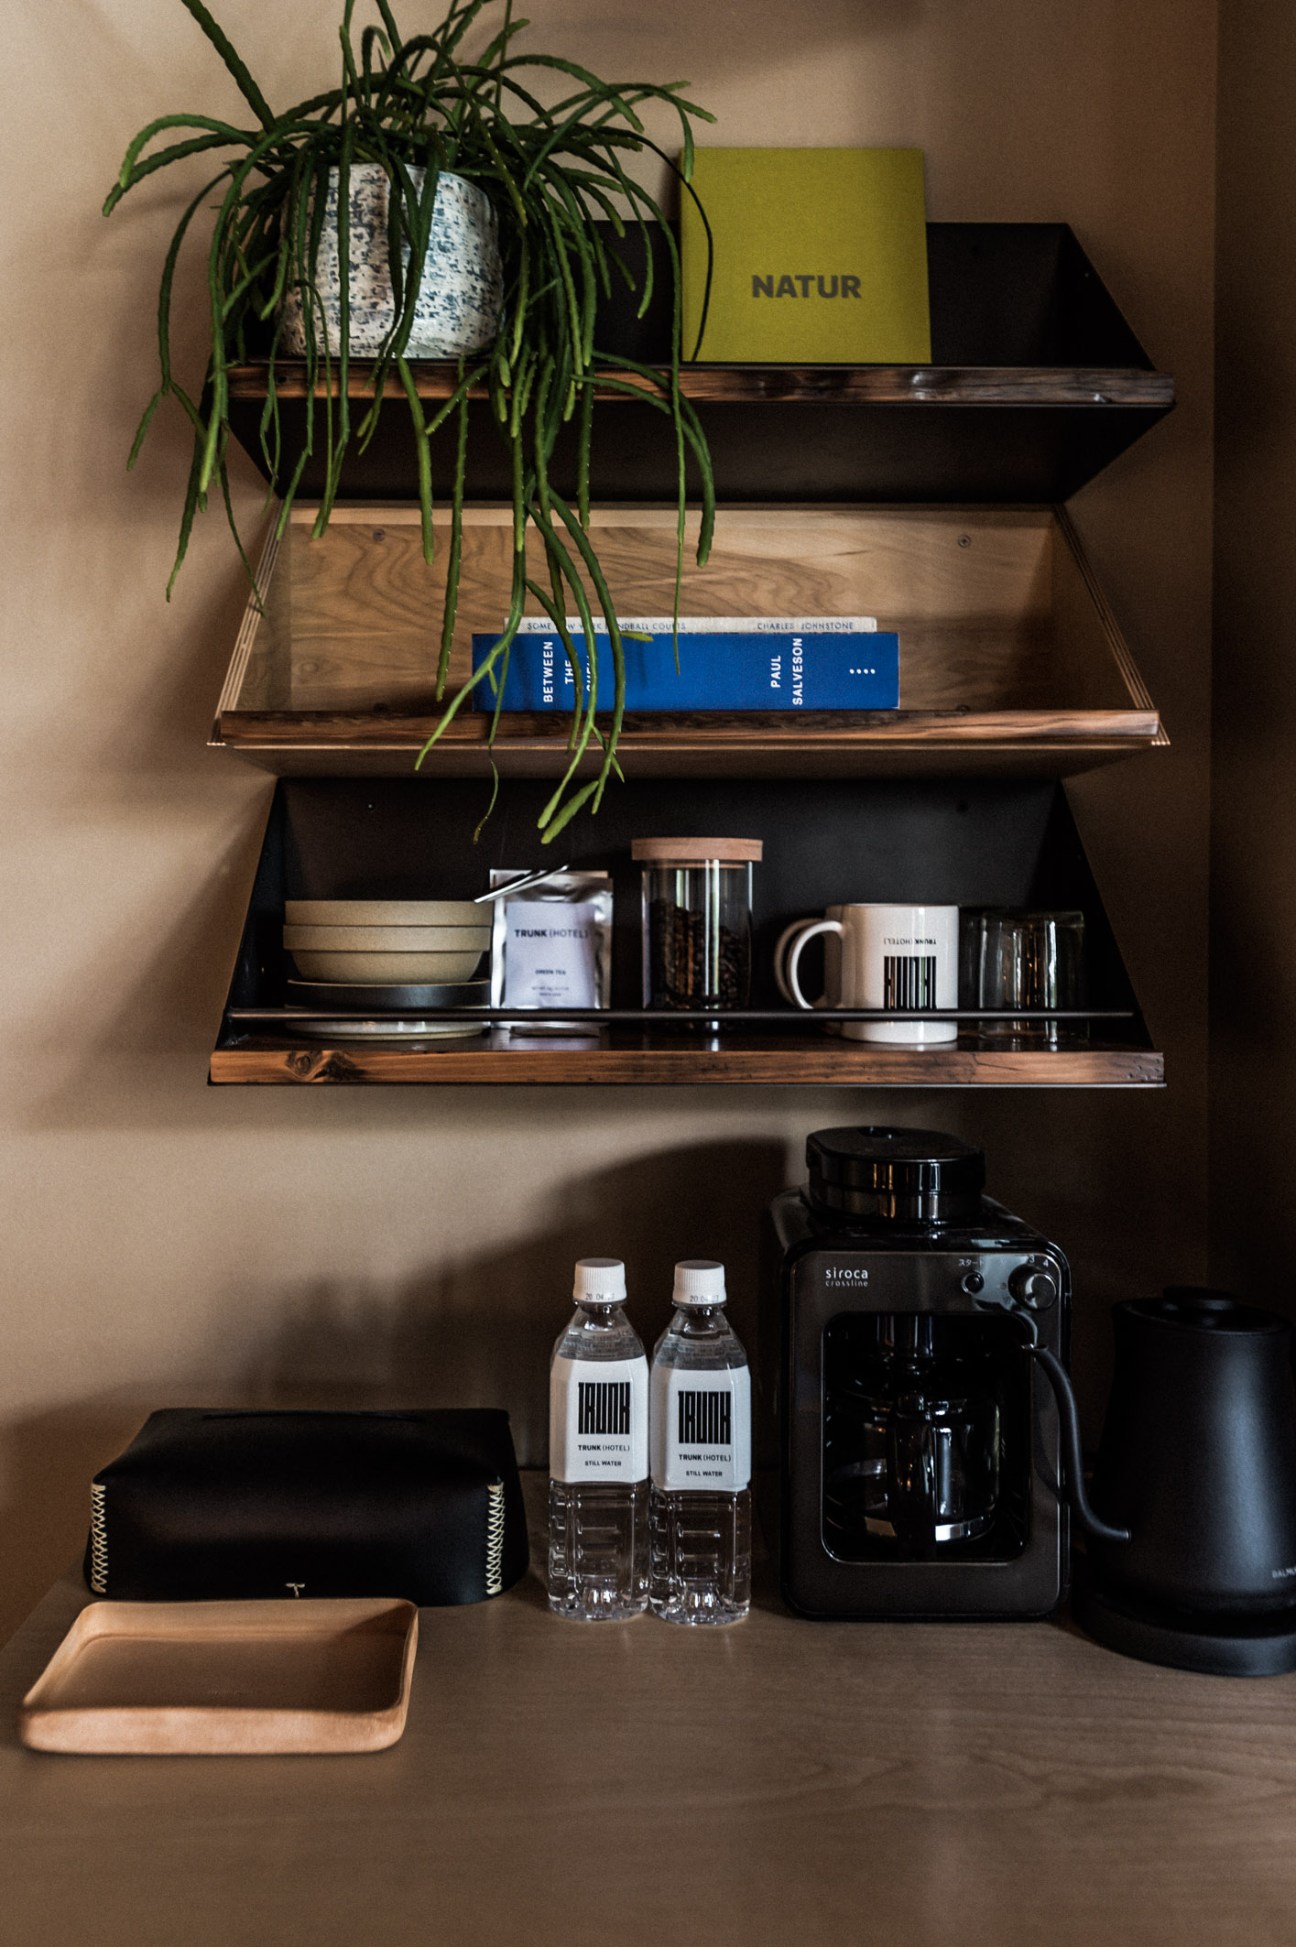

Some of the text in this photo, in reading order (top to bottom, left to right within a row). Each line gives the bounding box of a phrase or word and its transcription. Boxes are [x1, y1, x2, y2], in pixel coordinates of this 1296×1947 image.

[752, 274, 862, 299] NATUR
[527, 622, 551, 632] SOME
[652, 622, 687, 632] COUTS
[757, 621, 854, 631] CHARLES JOHNSTONE
[543, 641, 554, 703] BETWEEN
[564, 660, 574, 685] THE
[770, 655, 782, 688] PAUL
[792, 638, 804, 706] SALVESON
[514, 928, 548, 938] TRUNK
[825, 1266, 869, 1279] siroca
[825, 1279, 869, 1288] crossline
[578, 1382, 631, 1435] TRUNK
[677, 1391, 732, 1445] TRUNK
[577, 1444, 631, 1452] TRUNK (HOTEL)
[678, 1453, 732, 1463] TRUNK (HOTEL)
